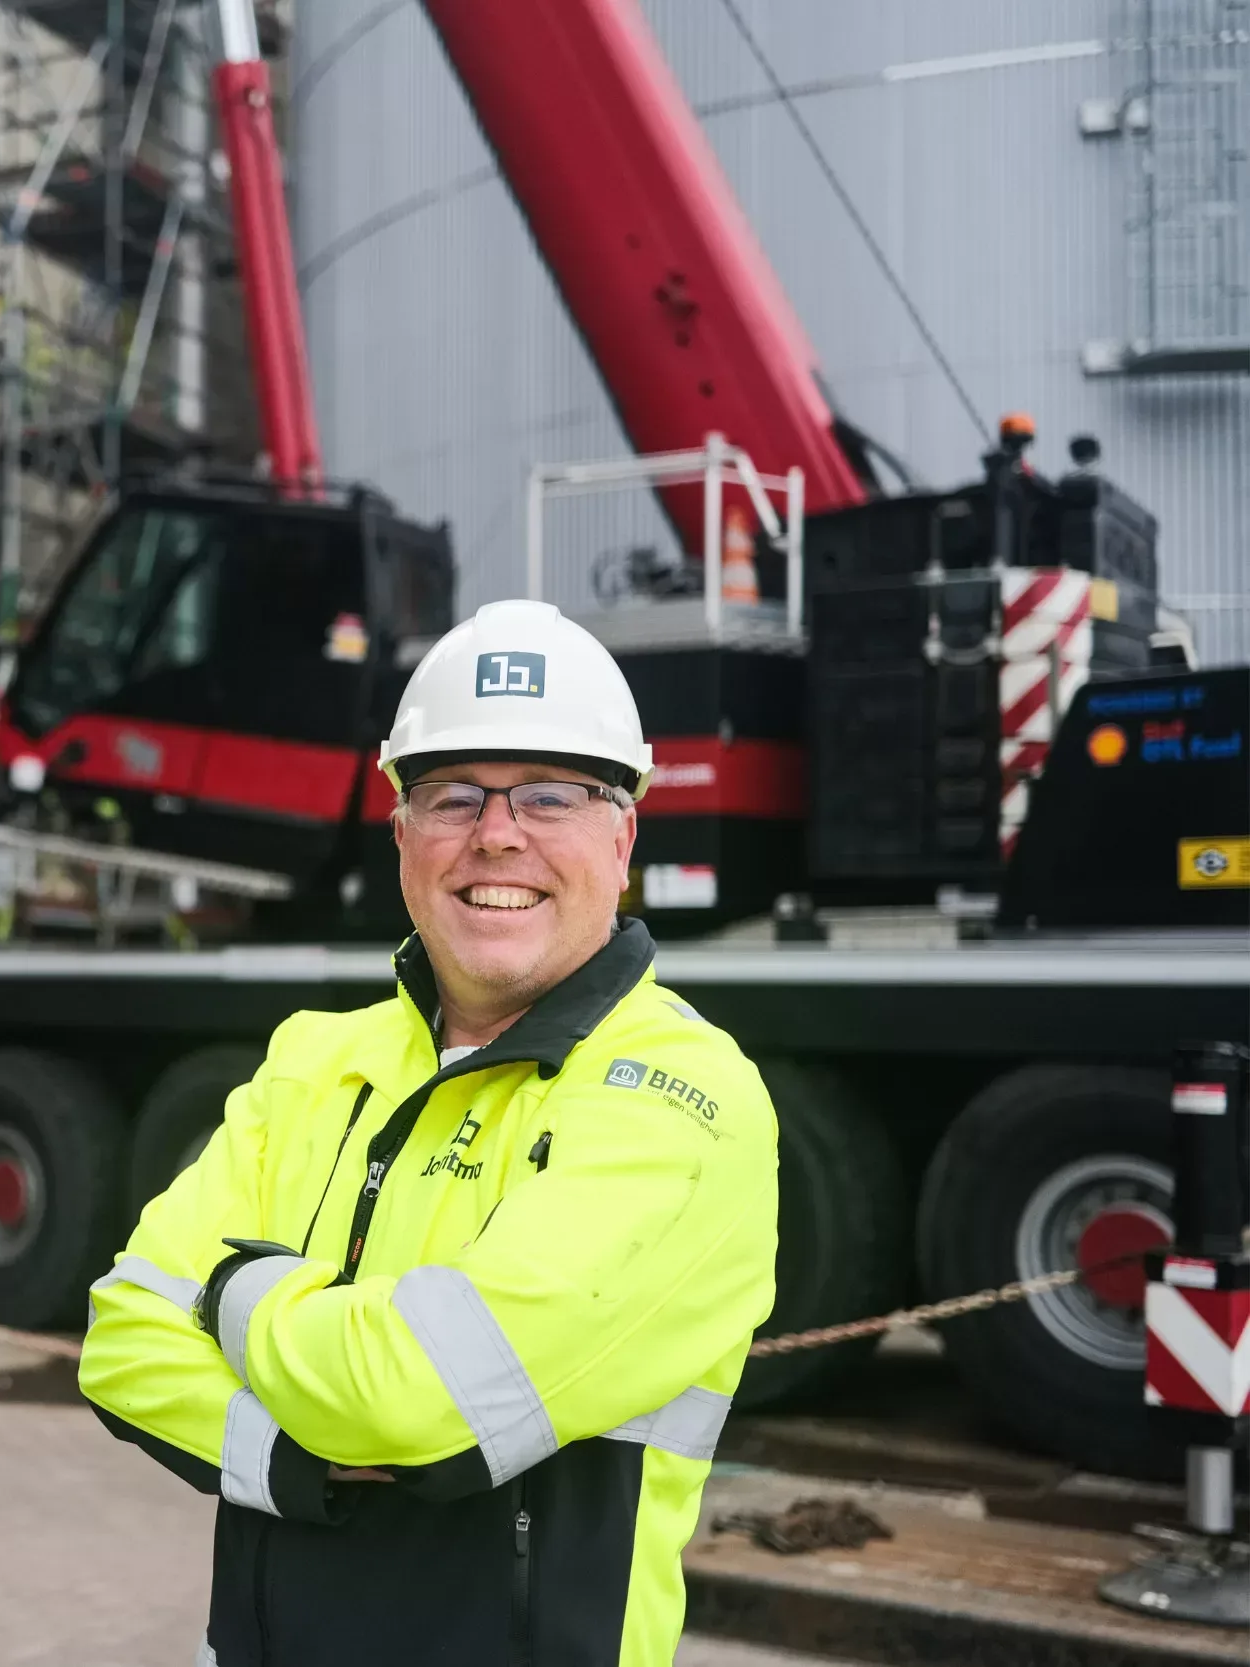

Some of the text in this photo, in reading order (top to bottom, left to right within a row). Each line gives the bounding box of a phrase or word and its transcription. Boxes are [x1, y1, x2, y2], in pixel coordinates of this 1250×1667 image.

[648, 1069, 719, 1121] BAAS
[662, 1093, 721, 1141] eigen veiligheid
